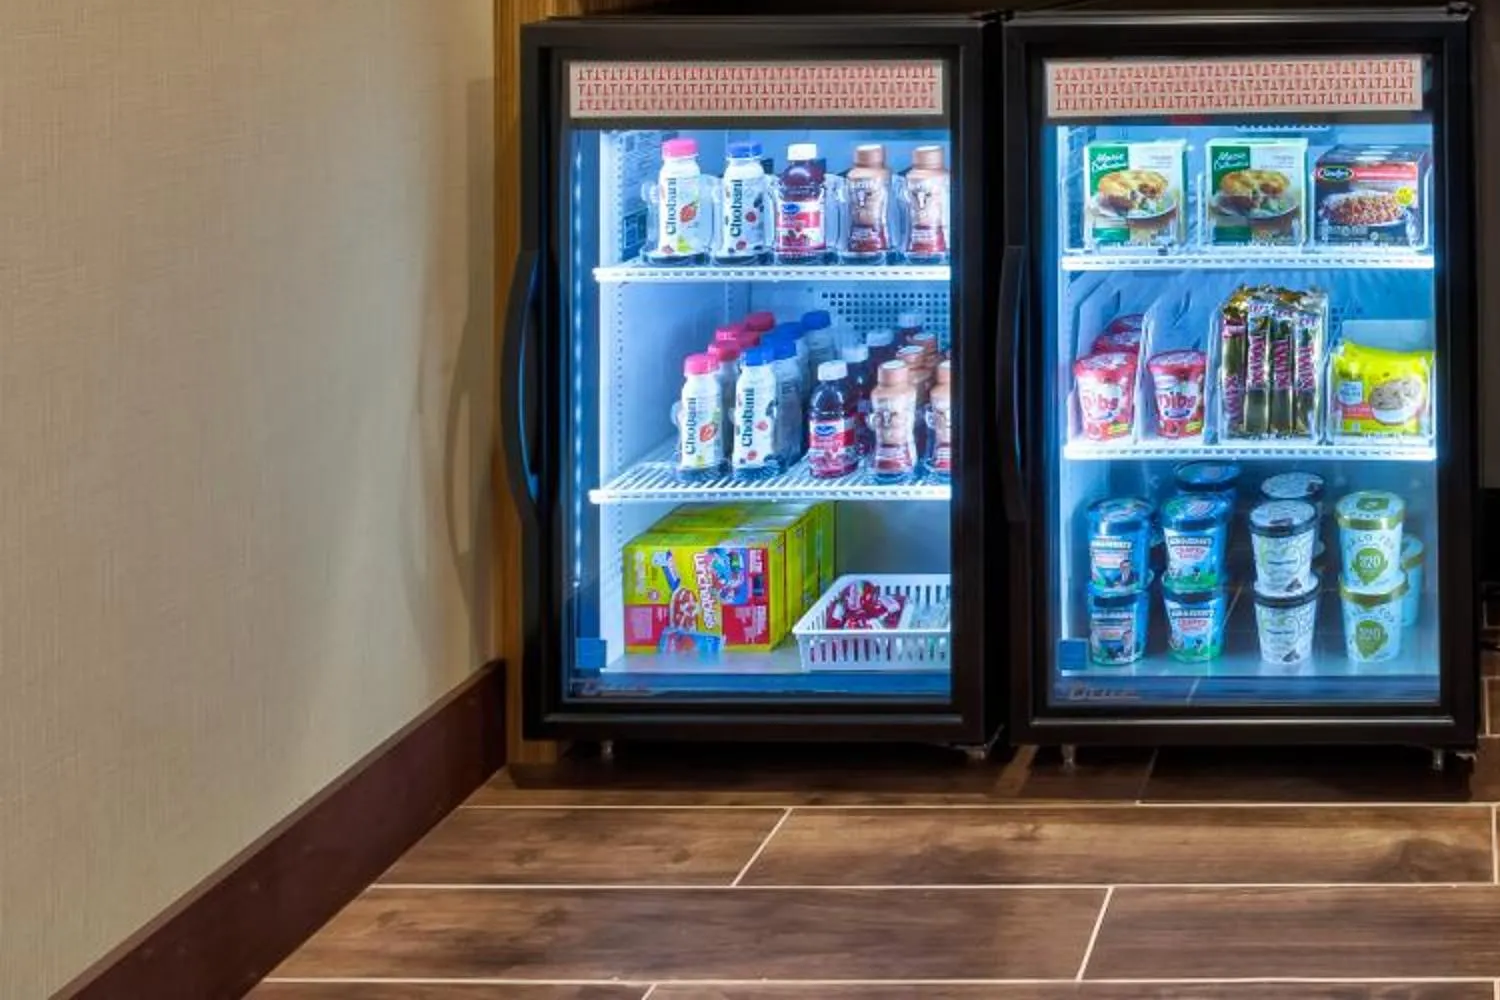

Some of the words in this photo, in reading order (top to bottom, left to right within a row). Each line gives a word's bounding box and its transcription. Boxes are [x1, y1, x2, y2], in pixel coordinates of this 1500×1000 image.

[665, 178, 677, 235] Chobani
[730, 179, 742, 237] Chobani
[684, 397, 697, 454] Chobani
[741, 387, 755, 447] Chobani
